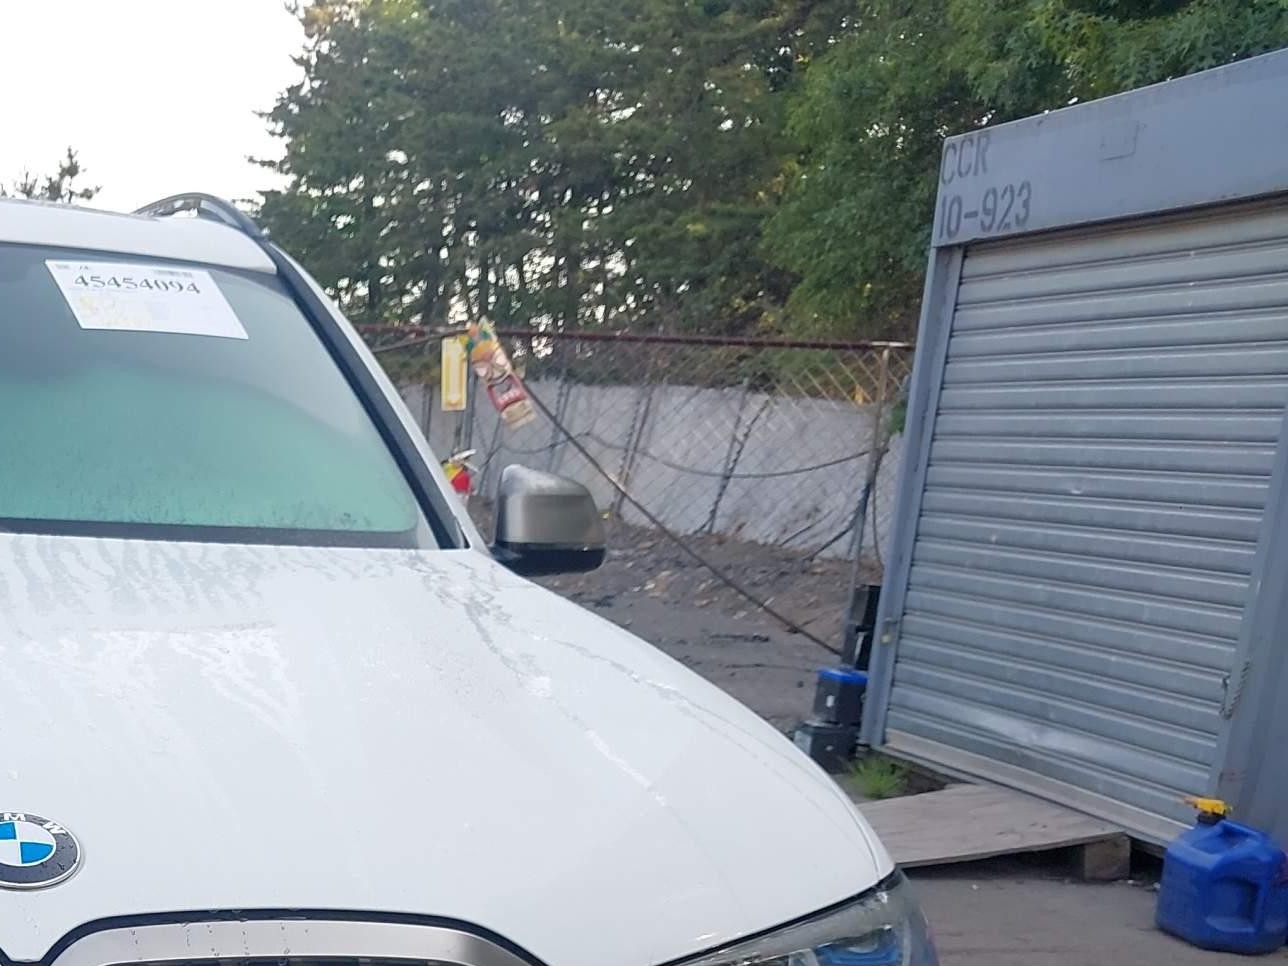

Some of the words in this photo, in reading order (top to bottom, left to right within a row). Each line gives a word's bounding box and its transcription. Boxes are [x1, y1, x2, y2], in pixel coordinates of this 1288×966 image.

[941, 134, 990, 185] CCR
[938, 180, 1032, 239] 10-923
[74, 274, 201, 295] 45454094
